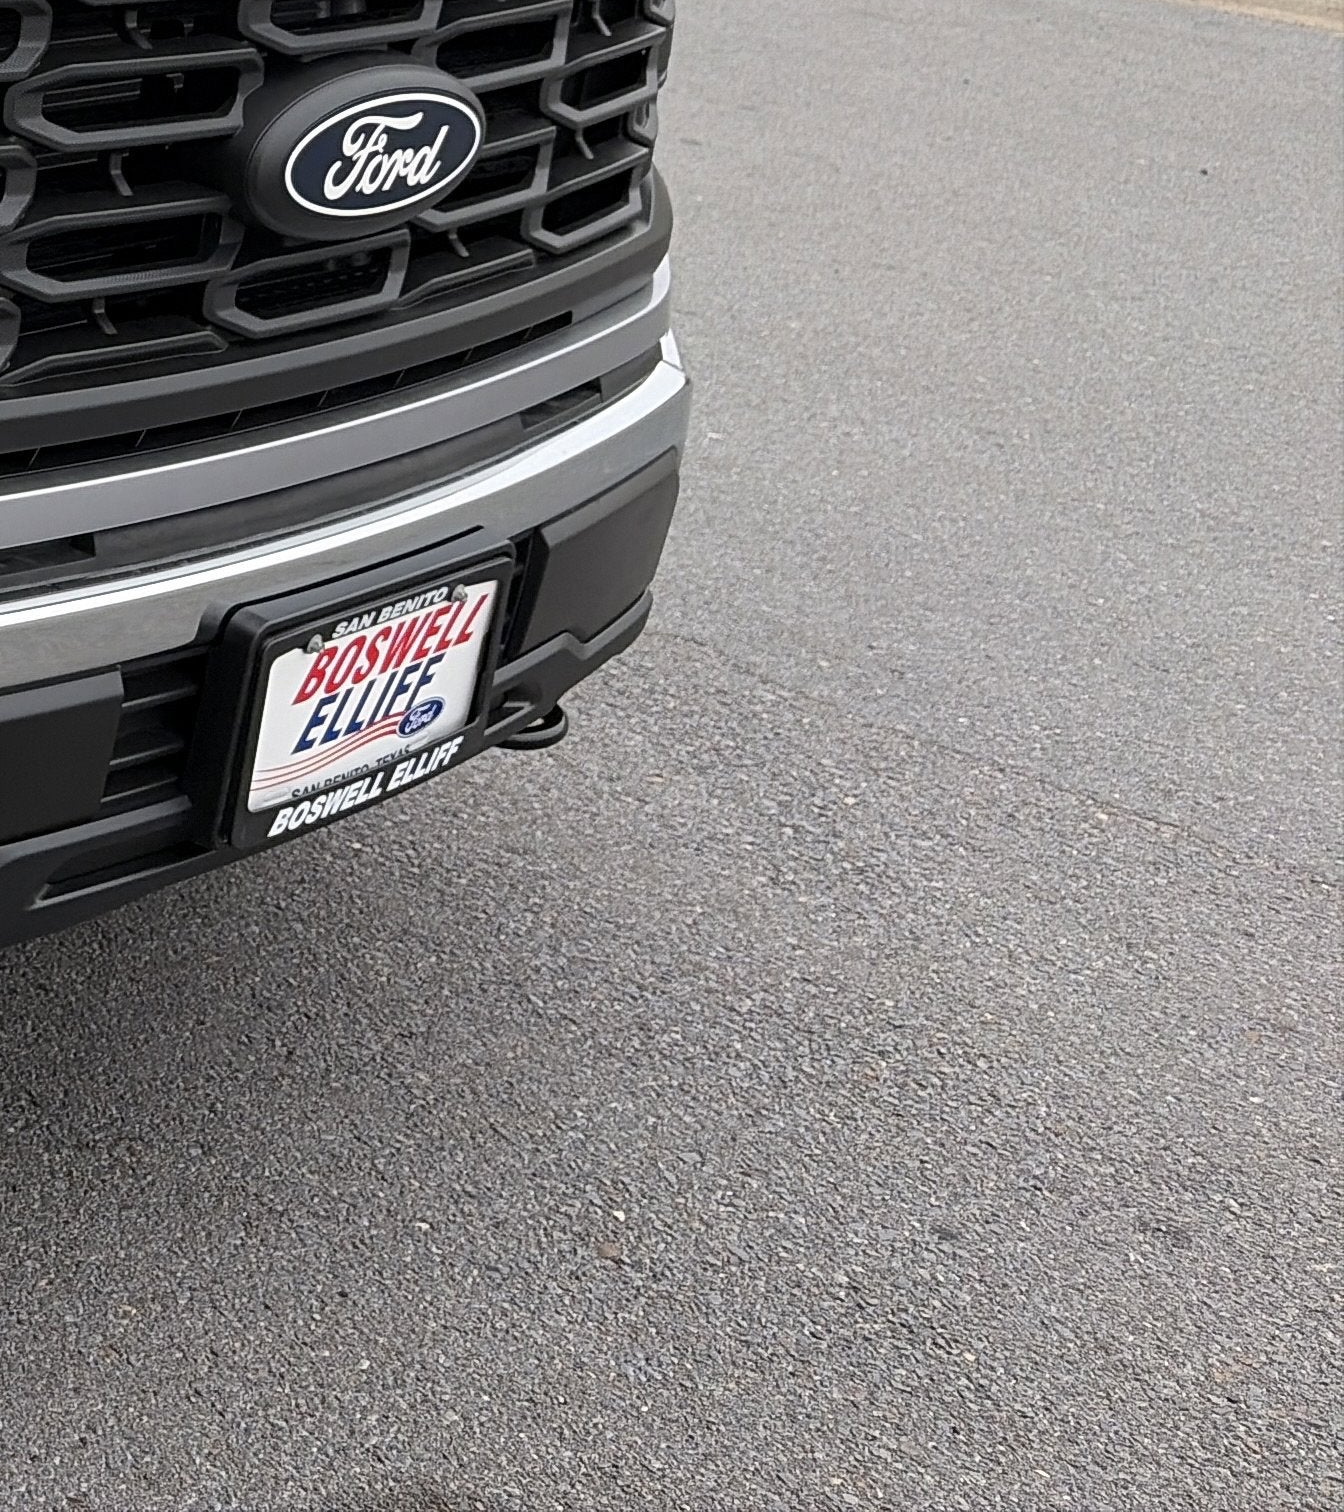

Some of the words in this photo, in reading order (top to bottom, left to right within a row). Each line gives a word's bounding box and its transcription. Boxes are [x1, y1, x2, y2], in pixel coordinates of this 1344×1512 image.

[323, 111, 451, 201] Ford
[291, 593, 489, 706] BOSWELL
[331, 613, 374, 639] SAN
[376, 586, 450, 626] BENITO
[290, 653, 446, 755] ELLIFF
[403, 700, 440, 734] Ford
[267, 772, 386, 839] BOSWELL
[386, 735, 464, 793] ELLIFF
